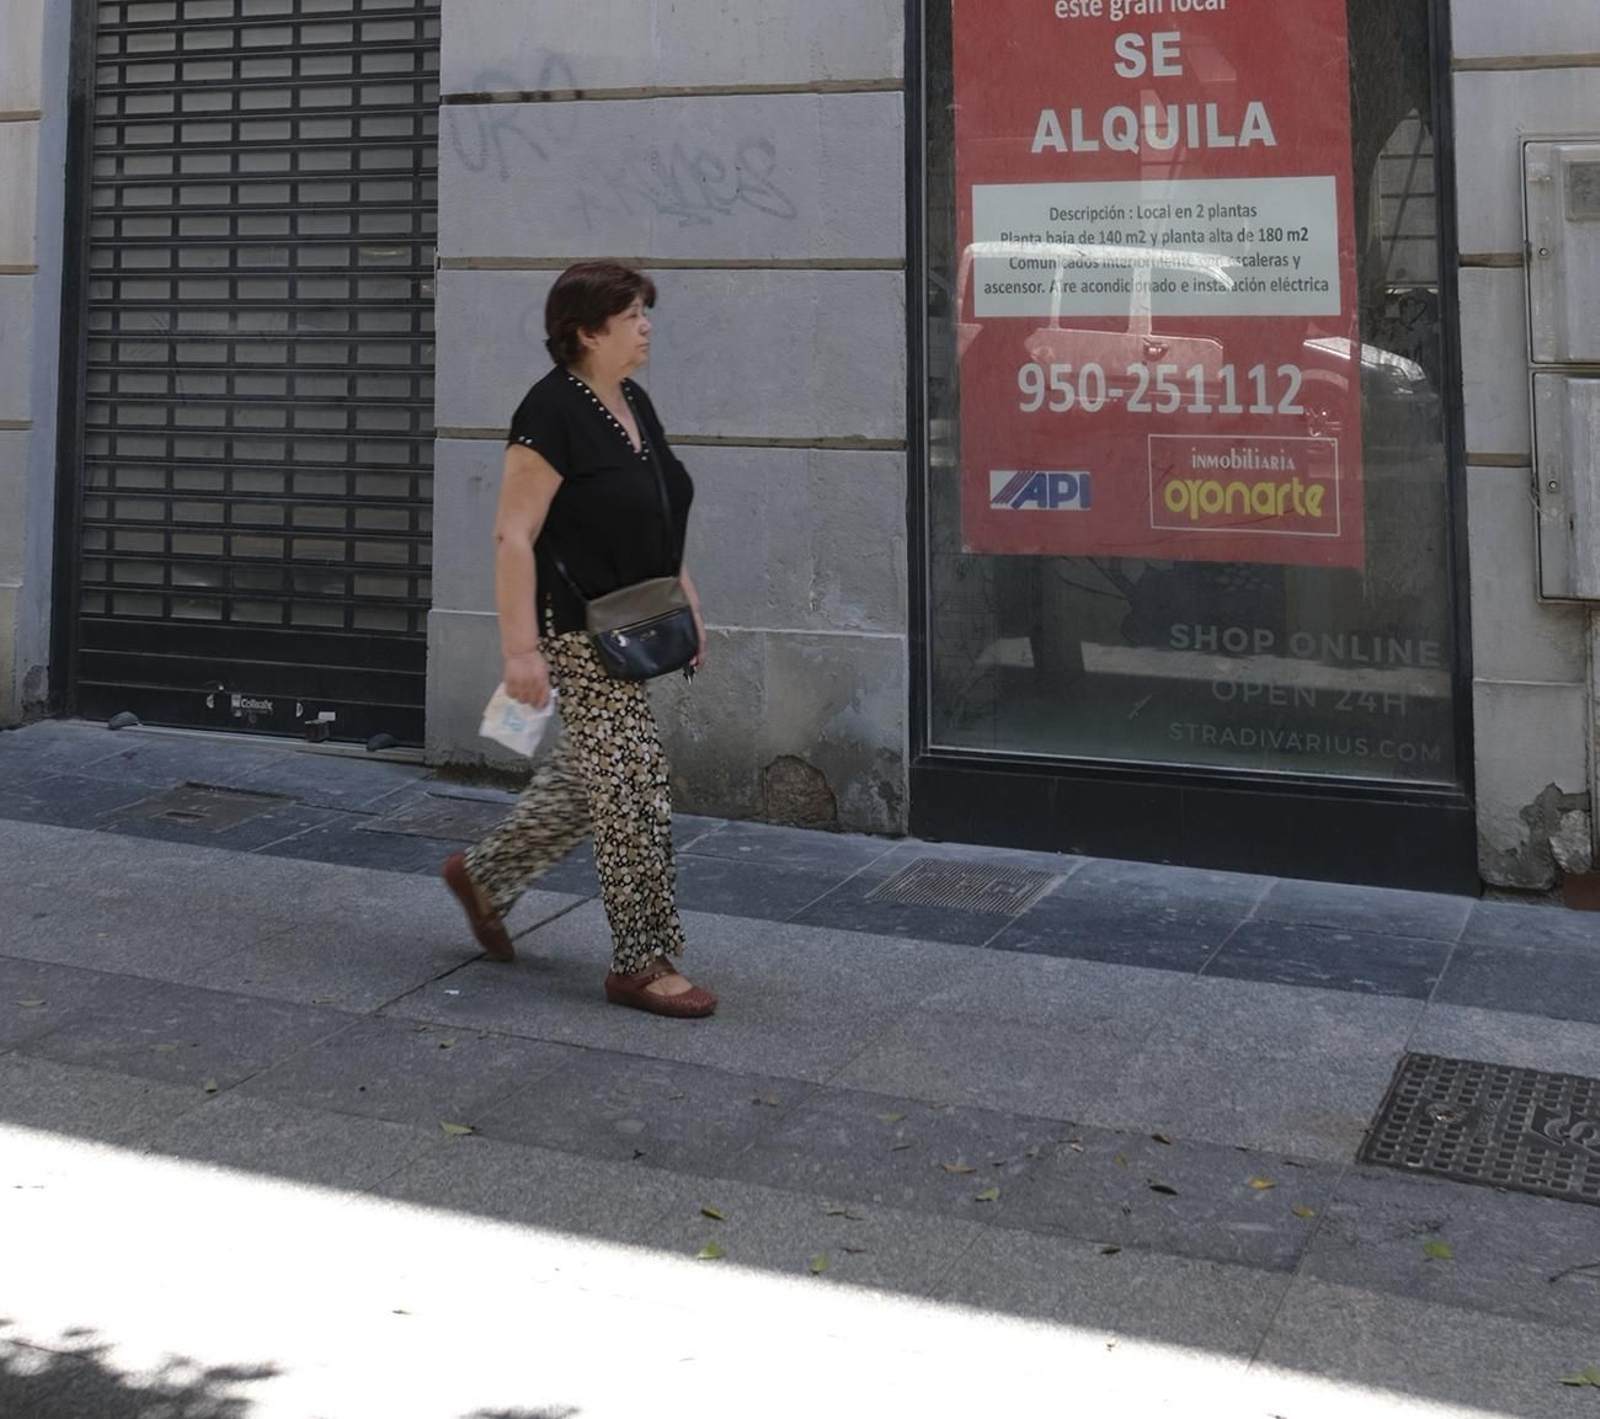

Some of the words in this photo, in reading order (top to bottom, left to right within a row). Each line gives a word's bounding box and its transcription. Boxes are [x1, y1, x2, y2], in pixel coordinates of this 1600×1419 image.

[1114, 31, 1182, 78] SE
[1031, 101, 1277, 154] ALQUILA
[1049, 204, 1125, 224] Descripción
[1137, 203, 1171, 220] Local
[1175, 207, 1192, 219] en
[1197, 204, 1205, 218] 2
[1208, 203, 1257, 221] plantas
[1078, 230, 1095, 244] de
[1099, 230, 1122, 245] 140
[1126, 230, 1147, 244] m2
[1150, 232, 1159, 247] y
[1162, 228, 1205, 247] planta
[1209, 228, 1233, 243] alta
[1237, 227, 1254, 243] de
[1258, 226, 1284, 242] 180
[1287, 226, 1309, 242] m2
[1291, 253, 1301, 270] y
[984, 280, 1045, 294] ascensor.
[1181, 280, 1189, 293] e
[1270, 275, 1329, 292] eléctrica
[1018, 362, 1304, 414] 950-251112
[1012, 472, 1090, 509] API
[1170, 624, 1275, 653] SHOP
[1289, 633, 1440, 667] ONLINE
[1212, 680, 1316, 709] OPEN
[1335, 688, 1406, 715] 24H
[1170, 722, 1440, 763] STRADIVARIUS.COM
